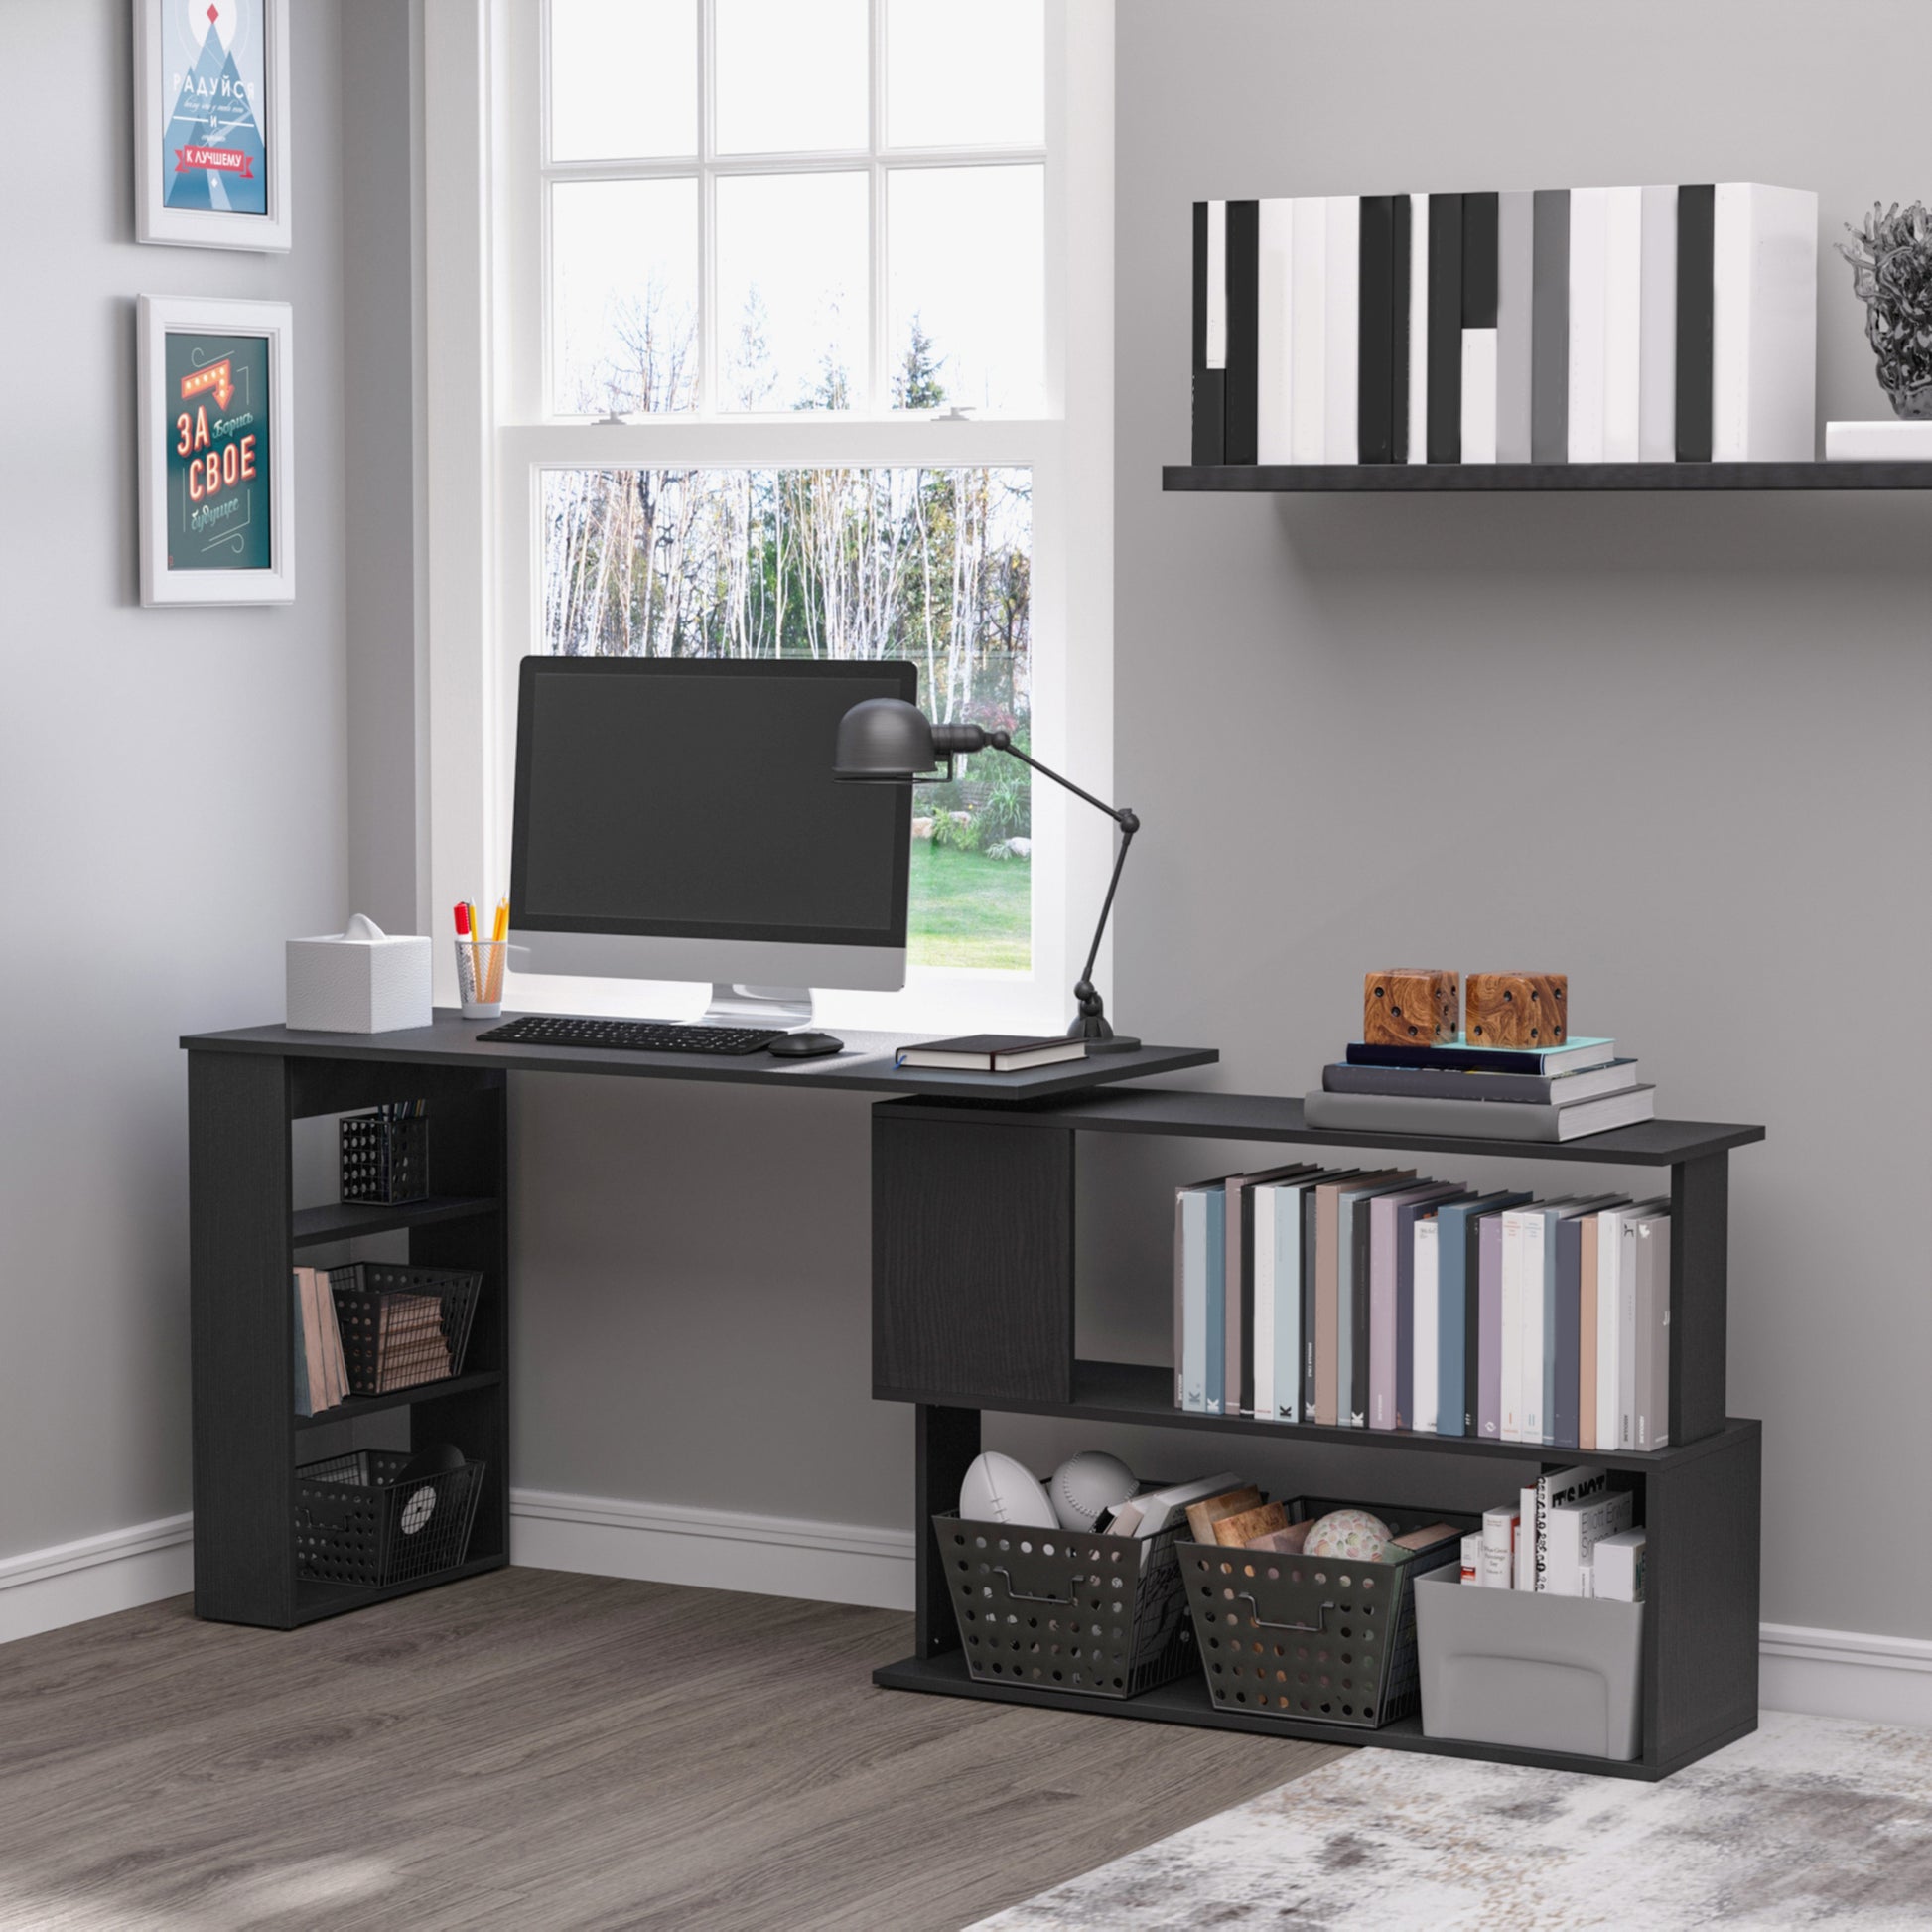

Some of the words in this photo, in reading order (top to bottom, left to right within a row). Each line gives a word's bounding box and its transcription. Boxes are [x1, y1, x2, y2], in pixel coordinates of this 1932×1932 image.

[173, 73, 255, 100] РАДУЙСЯ
[186, 150, 193, 162] К
[194, 151, 242, 167] ЛУЧШЕМУ
[177, 405, 210, 457] ЗА
[212, 412, 254, 439] Борись
[189, 434, 256, 502] СВОЕ
[191, 498, 239, 533] будущее
